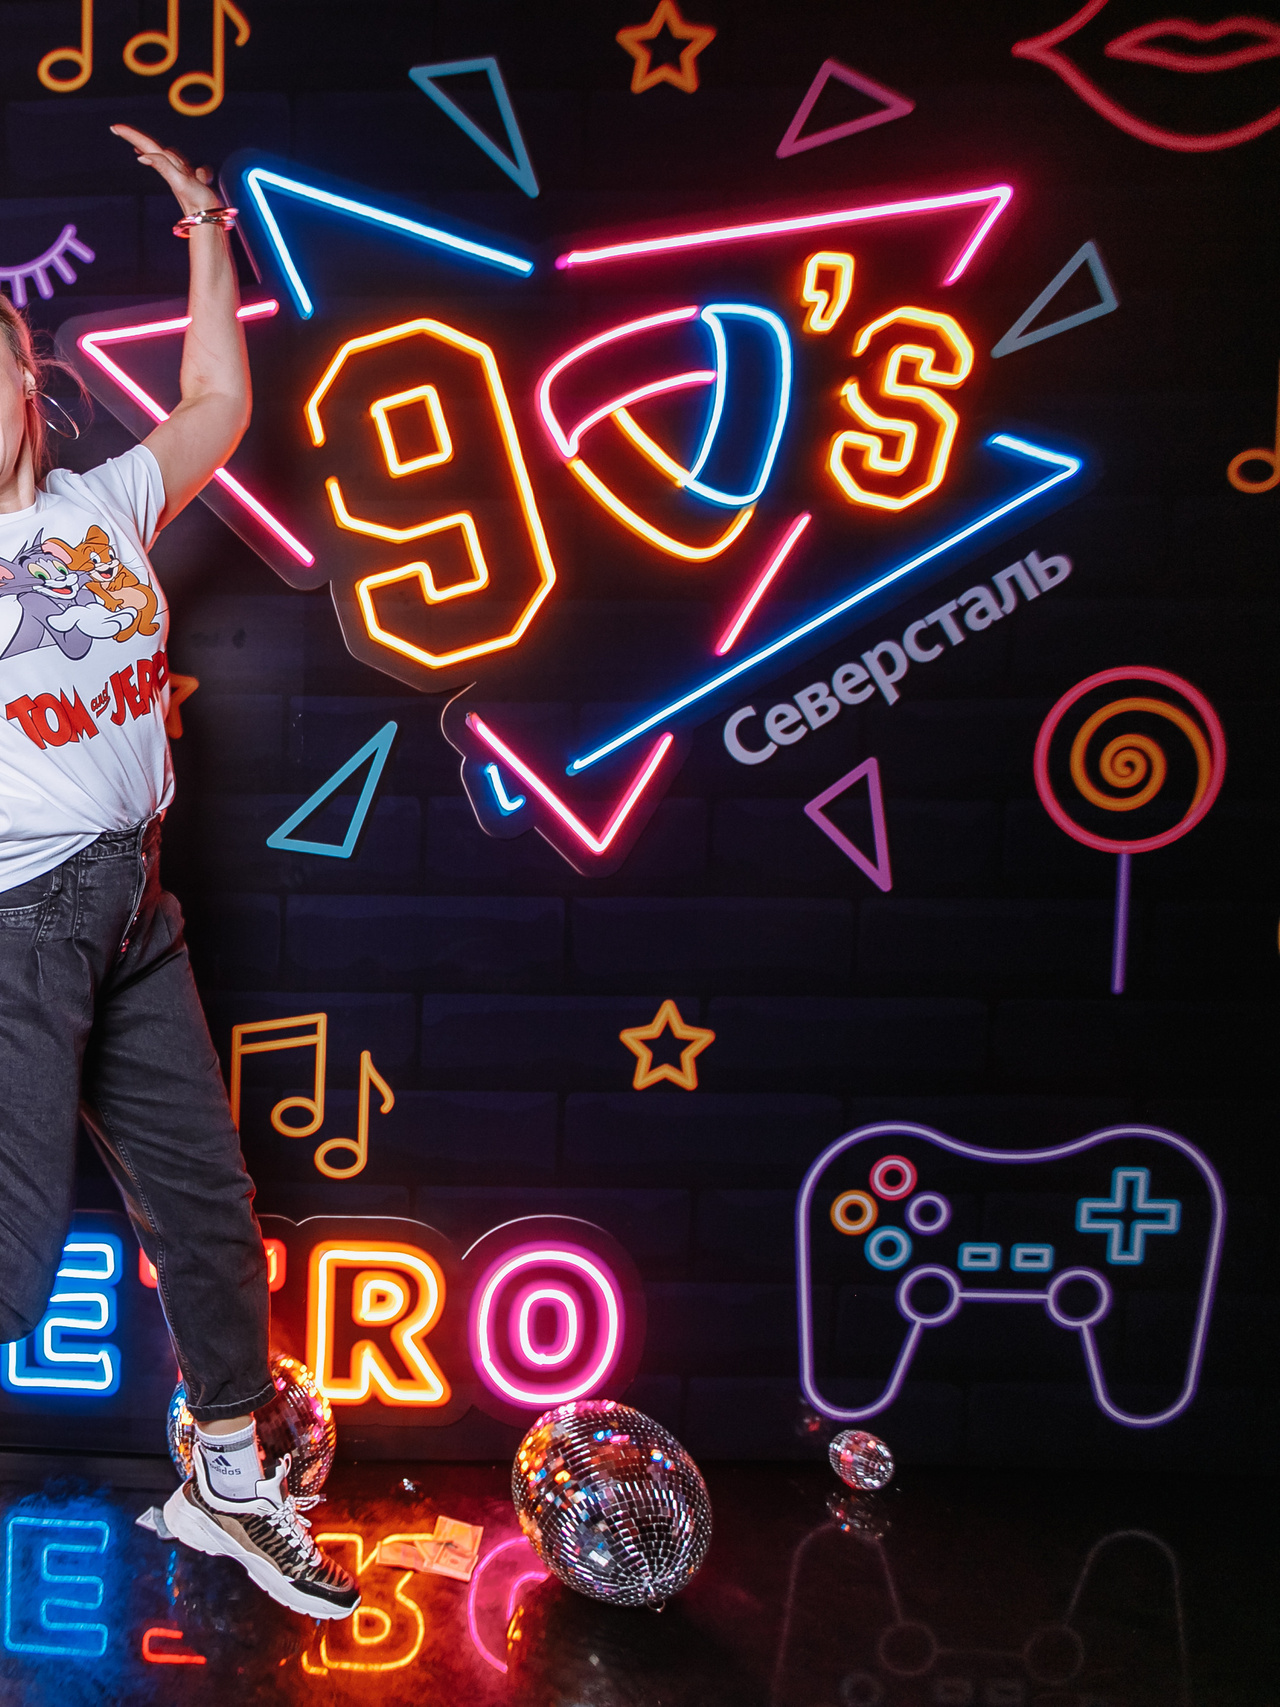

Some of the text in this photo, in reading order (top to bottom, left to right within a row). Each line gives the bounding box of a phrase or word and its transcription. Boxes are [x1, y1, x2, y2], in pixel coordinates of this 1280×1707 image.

[5, 651, 168, 750] TOM and JERR
[722, 549, 1074, 766] Северсталь
